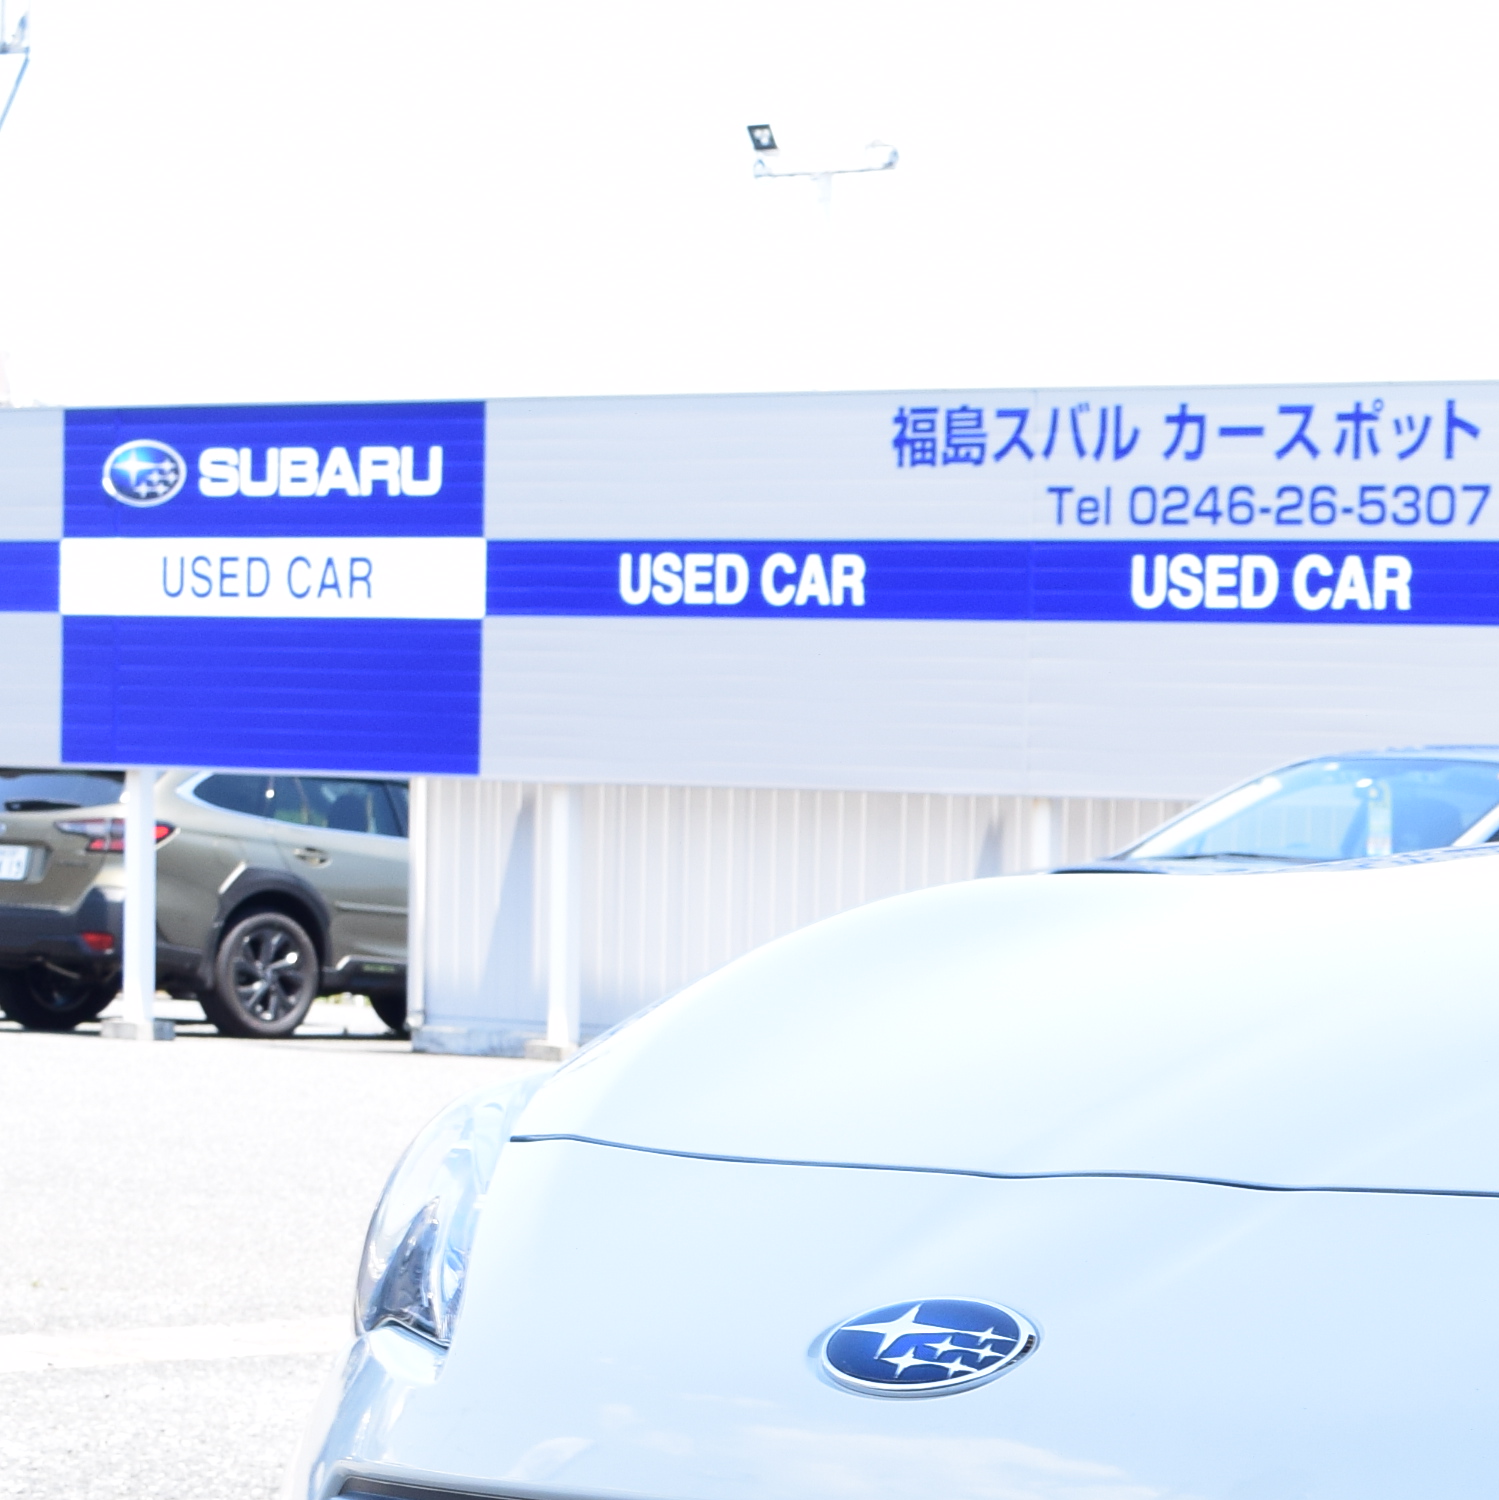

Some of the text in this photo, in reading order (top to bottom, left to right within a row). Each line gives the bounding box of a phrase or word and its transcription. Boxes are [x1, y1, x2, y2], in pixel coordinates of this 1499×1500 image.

[891, 402, 1140, 468] 福島スバル
[1162, 398, 1480, 461] カースポット
[199, 446, 442, 497] SUBARU
[1046, 484, 1493, 527] Tel 0246-26-5307
[163, 556, 373, 600] USED CAR
[619, 552, 866, 607] USED CAR
[1130, 553, 1413, 611] USED CAR
